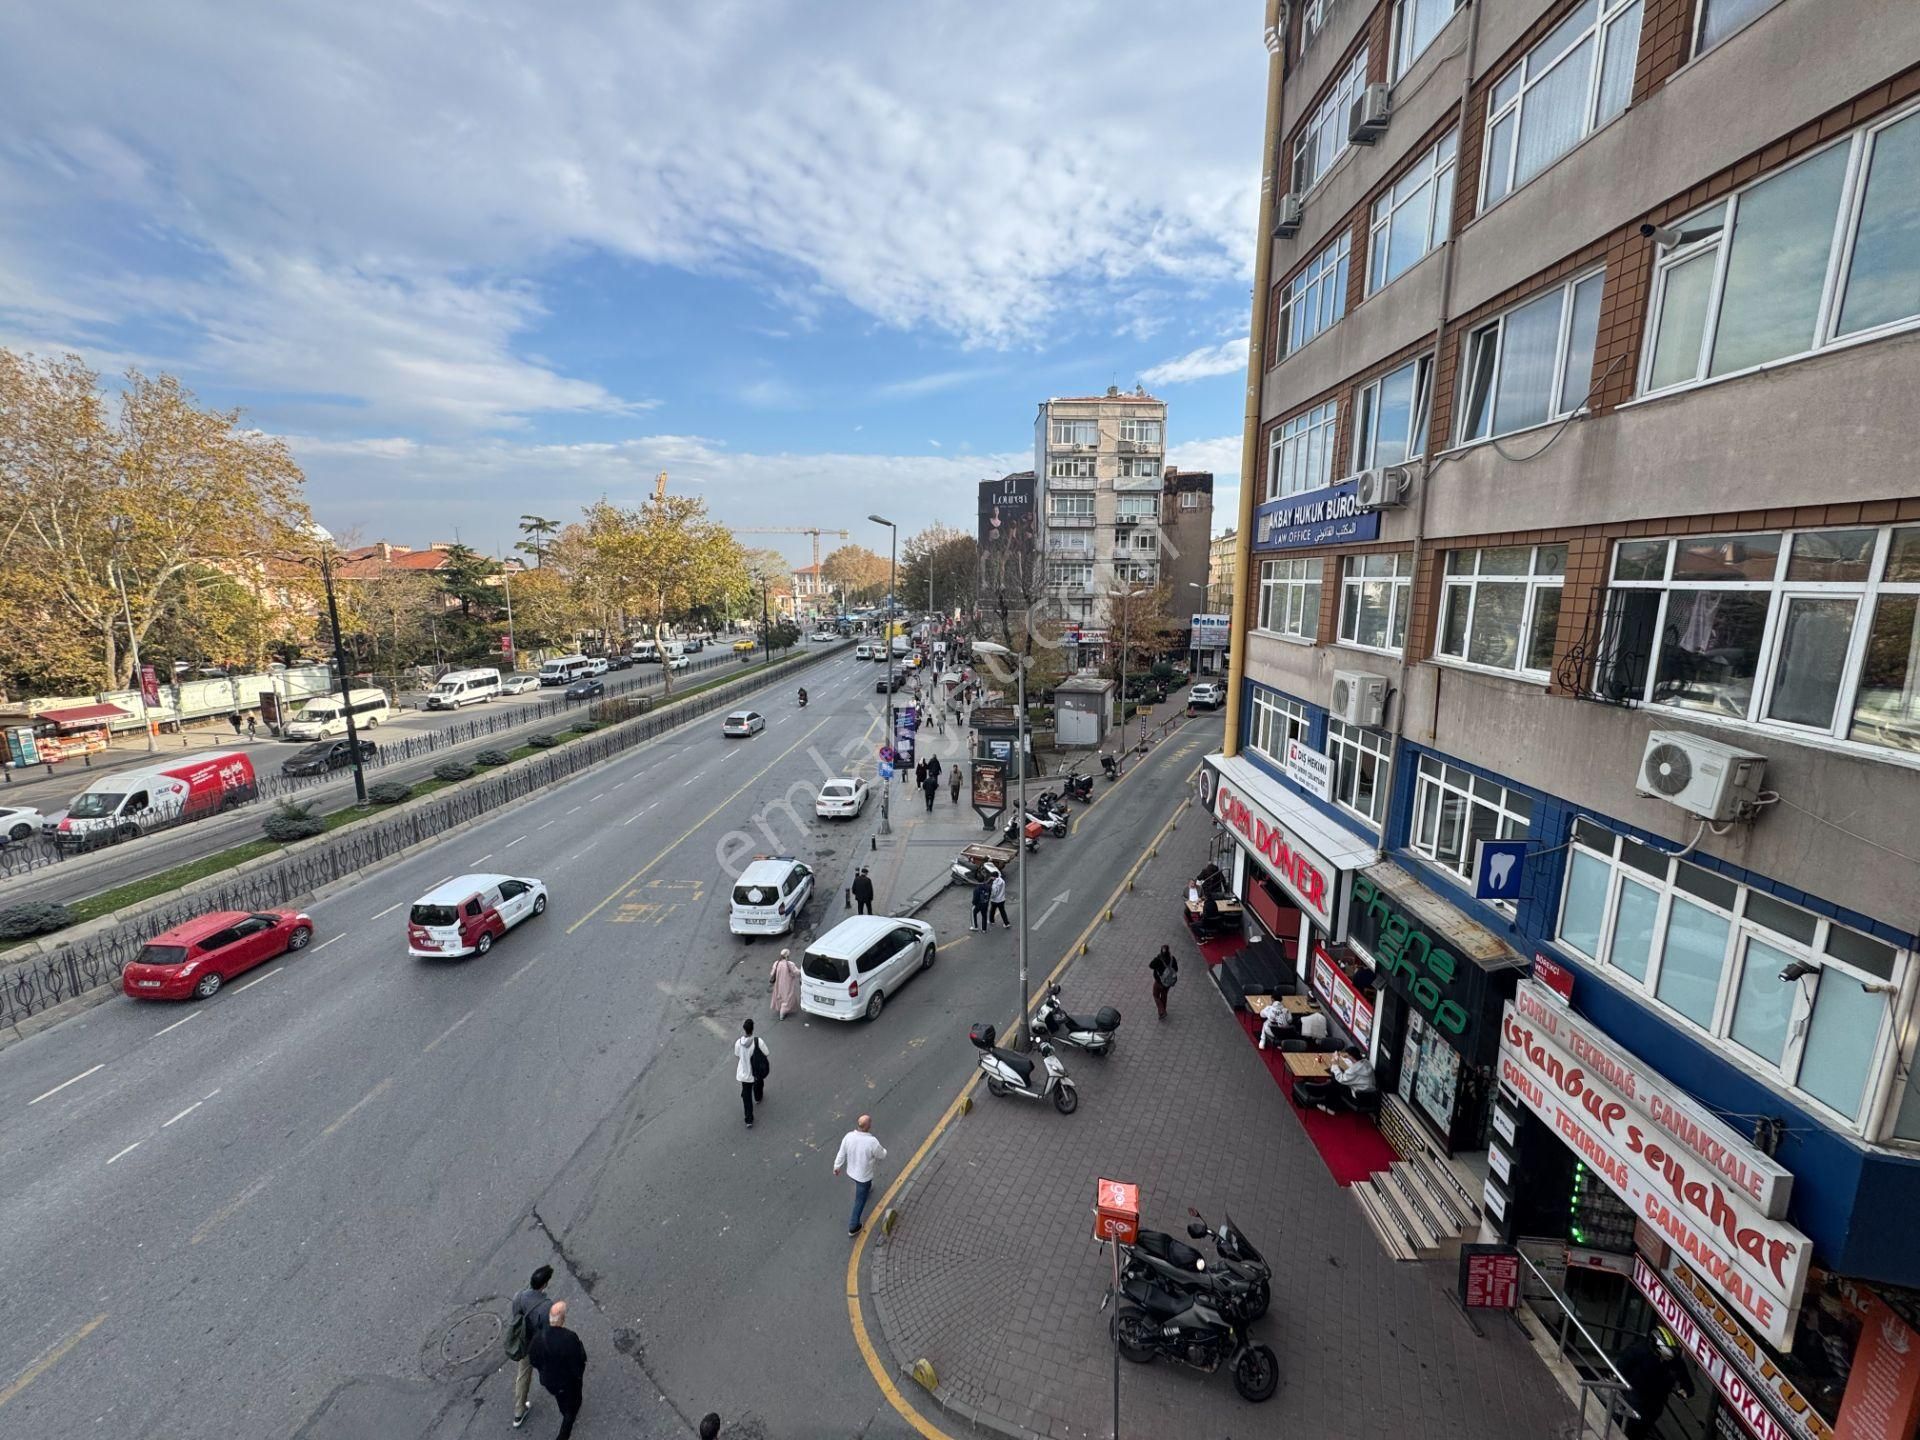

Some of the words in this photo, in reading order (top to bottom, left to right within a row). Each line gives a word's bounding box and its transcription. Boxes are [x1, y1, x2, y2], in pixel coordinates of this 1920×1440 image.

[1269, 507, 1293, 529] AKBAY
[1294, 501, 1325, 525] HUKUK
[1274, 532, 1288, 545] LAW
[1288, 529, 1312, 543] OFFICE
[1256, 818, 1329, 917] DÖNER
[1519, 990, 1558, 1036] ÇORLU
[1651, 1094, 1765, 1202] ÇANAKKALE
[1503, 1059, 1544, 1109] ÇORLU
[1644, 1193, 1774, 1329] ÇANAKKALE
[1672, 1259, 1757, 1363] ARDA
[1695, 1336, 1718, 1372] ET
[1719, 1361, 1791, 1440] LOKAN
